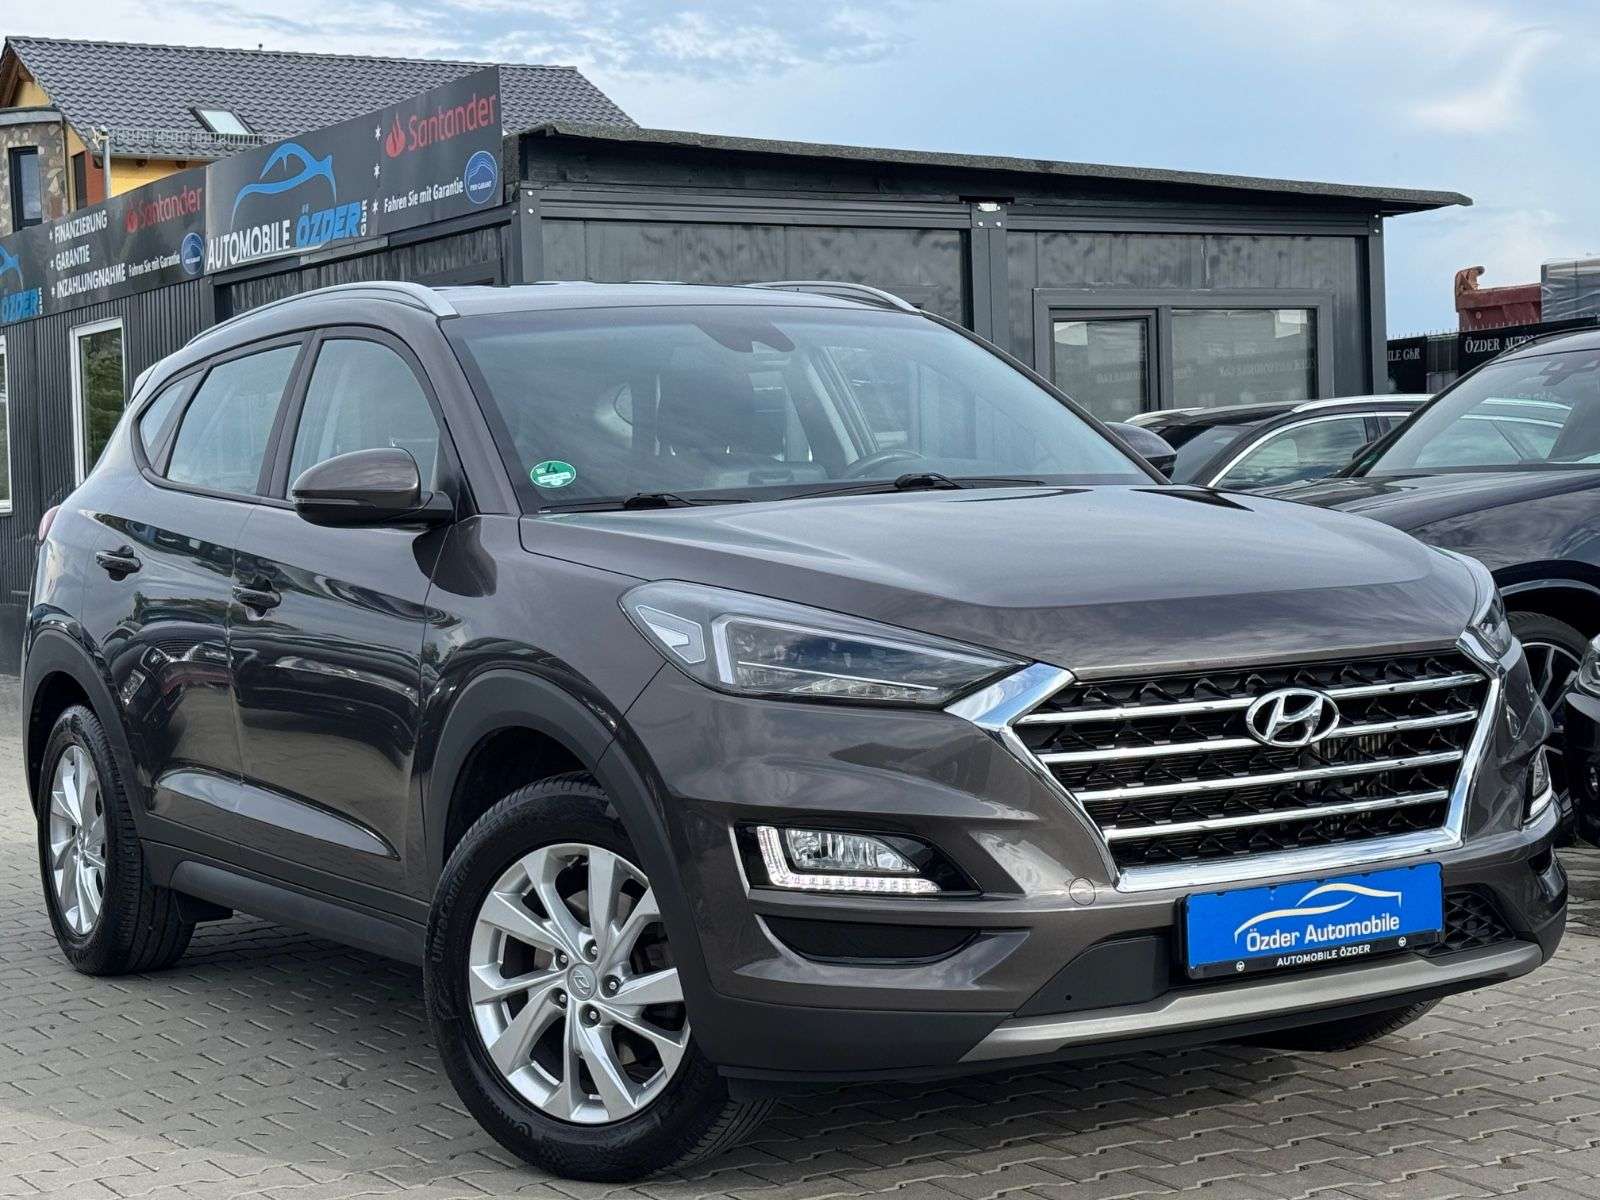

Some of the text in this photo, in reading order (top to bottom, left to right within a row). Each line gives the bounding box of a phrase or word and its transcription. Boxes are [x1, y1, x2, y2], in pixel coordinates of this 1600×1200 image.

[407, 94, 497, 152] Santander
[139, 186, 203, 228] Santander
[383, 176, 464, 214] Fahren Sie mit Garantie
[54, 209, 108, 244] FINANZIERUNG
[206, 219, 291, 271] AUTOMOBILE
[295, 200, 361, 248] ÖZDER
[56, 244, 91, 272] GARANTIE
[56, 262, 126, 299] INZAHLUNGNAHME
[1464, 336, 1500, 354] ÖZDER
[1246, 913, 1400, 953] Özder Automobile
[1276, 944, 1371, 967] AUTOMOBILE ÖZDER
